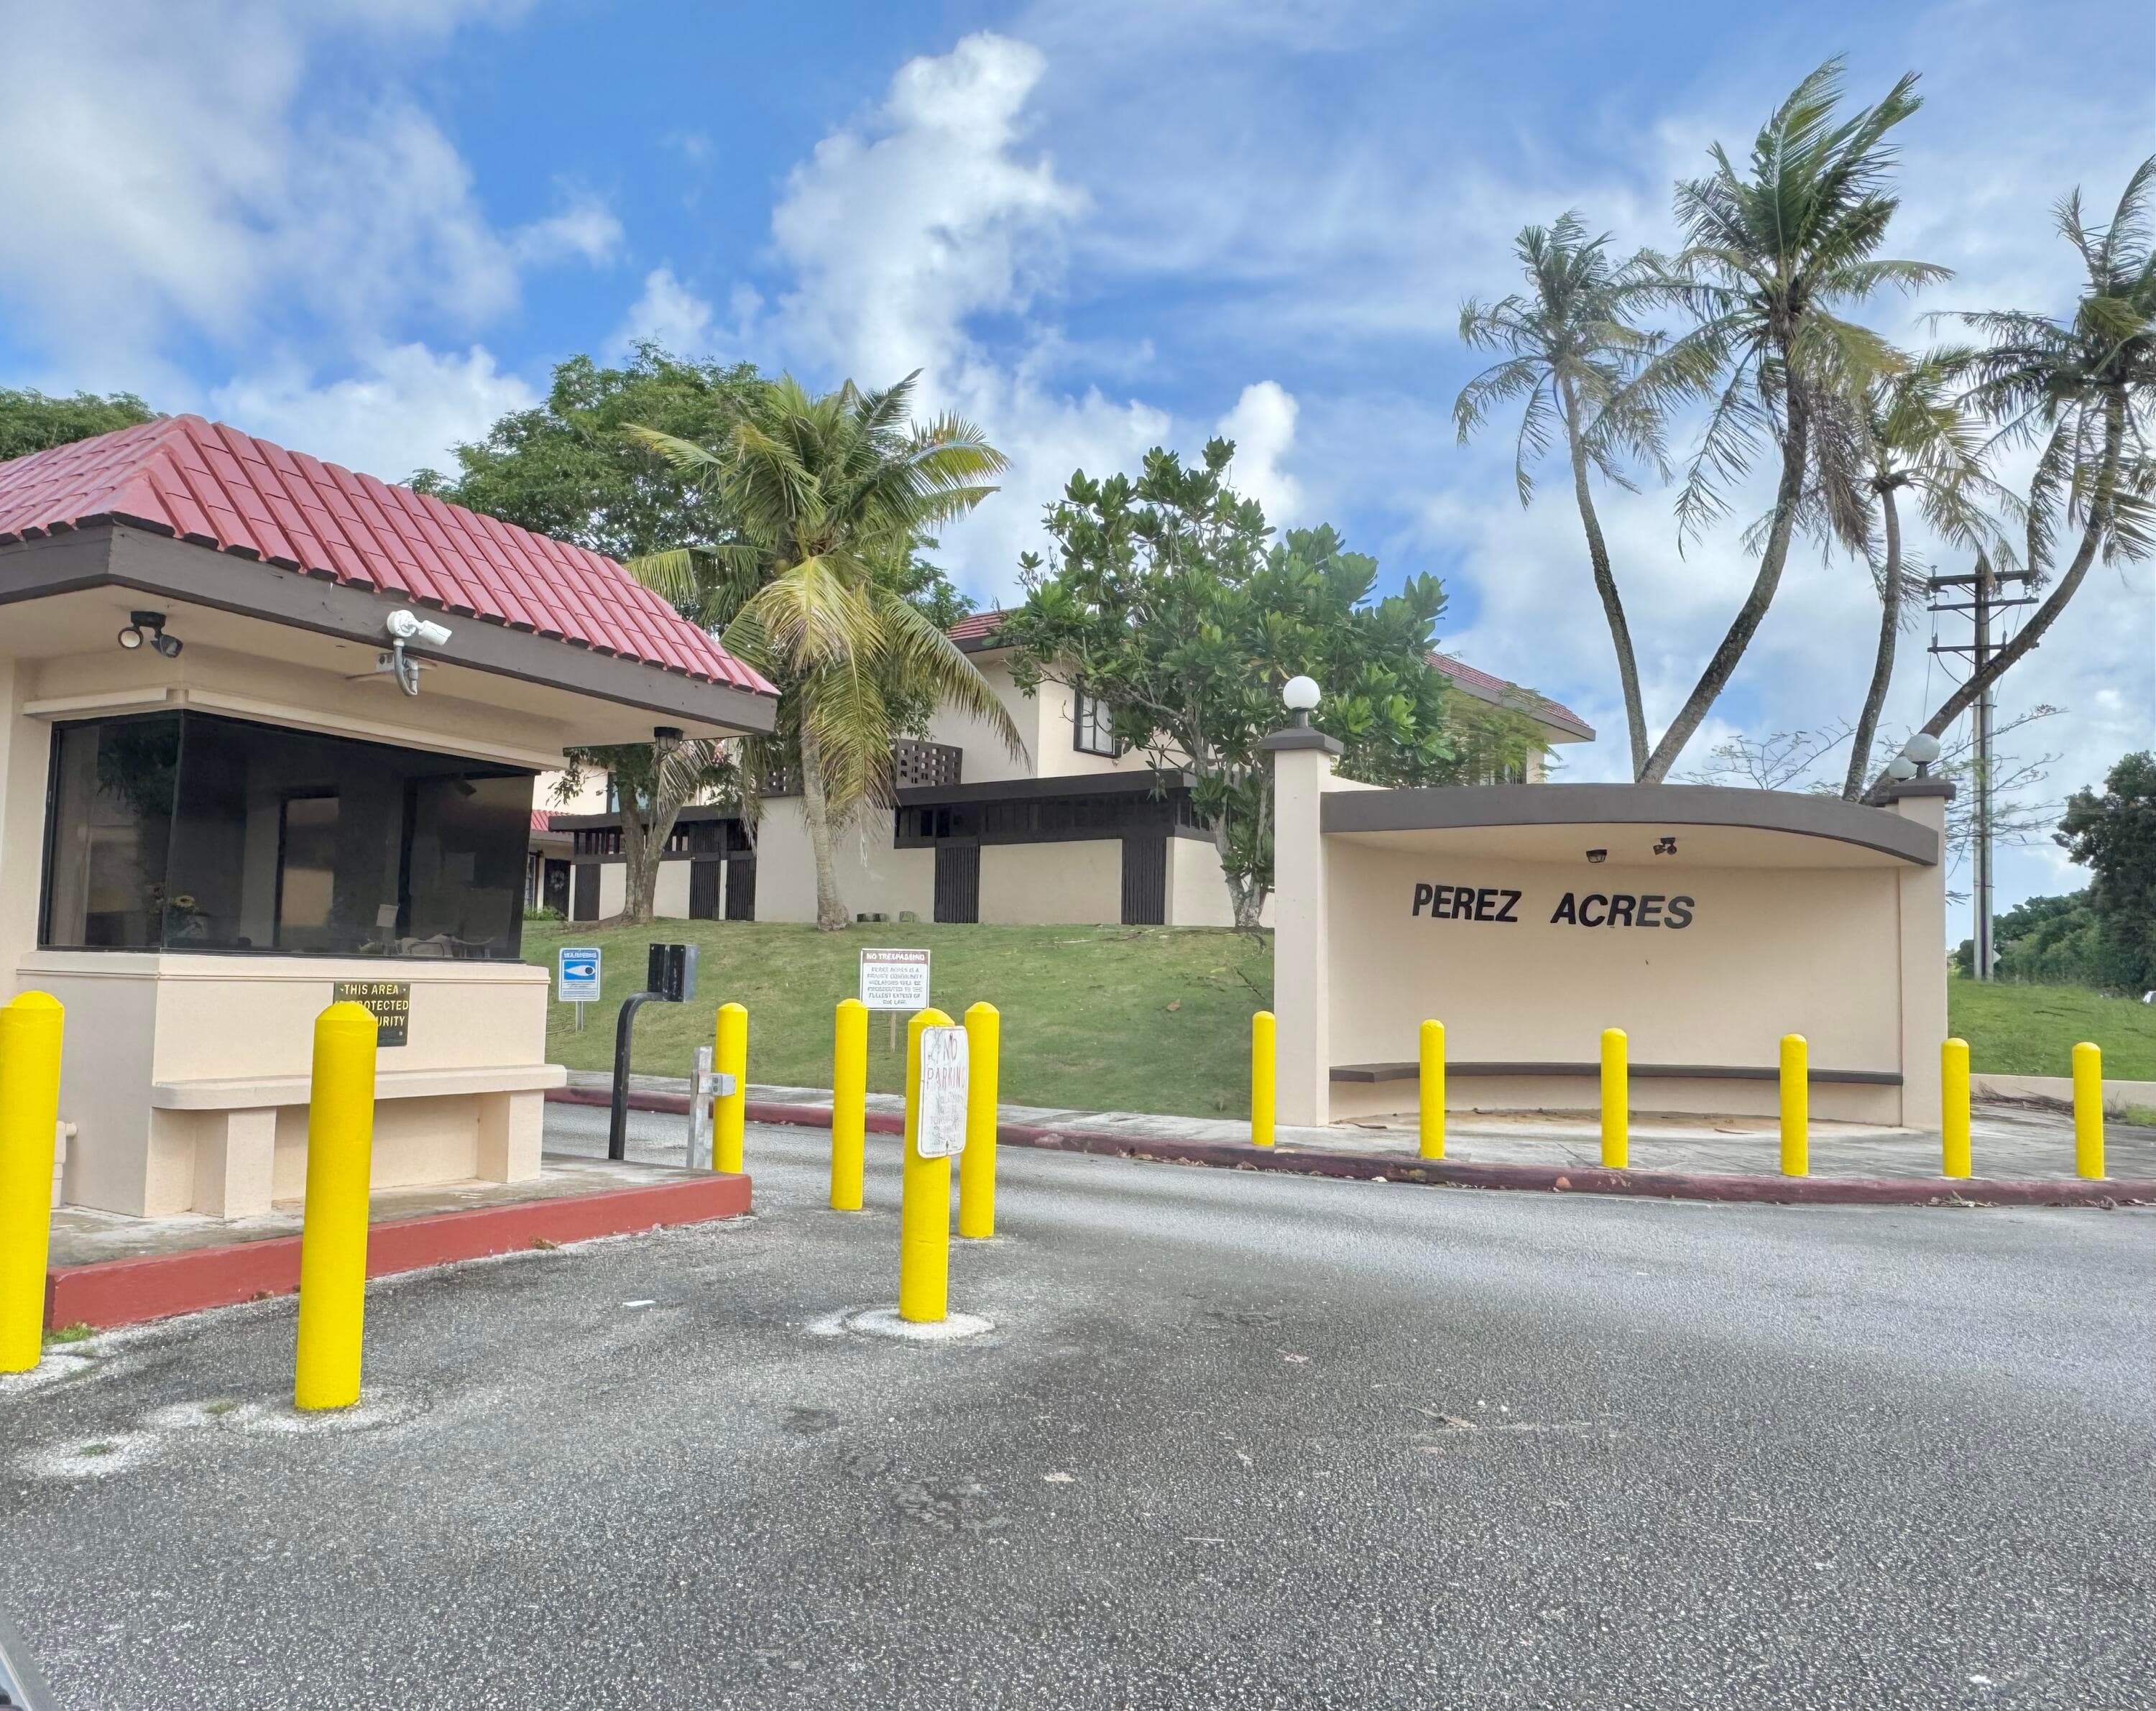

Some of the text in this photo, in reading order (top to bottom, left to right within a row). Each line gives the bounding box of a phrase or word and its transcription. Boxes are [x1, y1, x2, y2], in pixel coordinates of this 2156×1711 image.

[1412, 883, 1695, 929] PEREZ ACRES
[345, 984, 399, 995] THIS AREA
[943, 1037, 958, 1061] NO
[926, 1067, 967, 1091] PARKING
